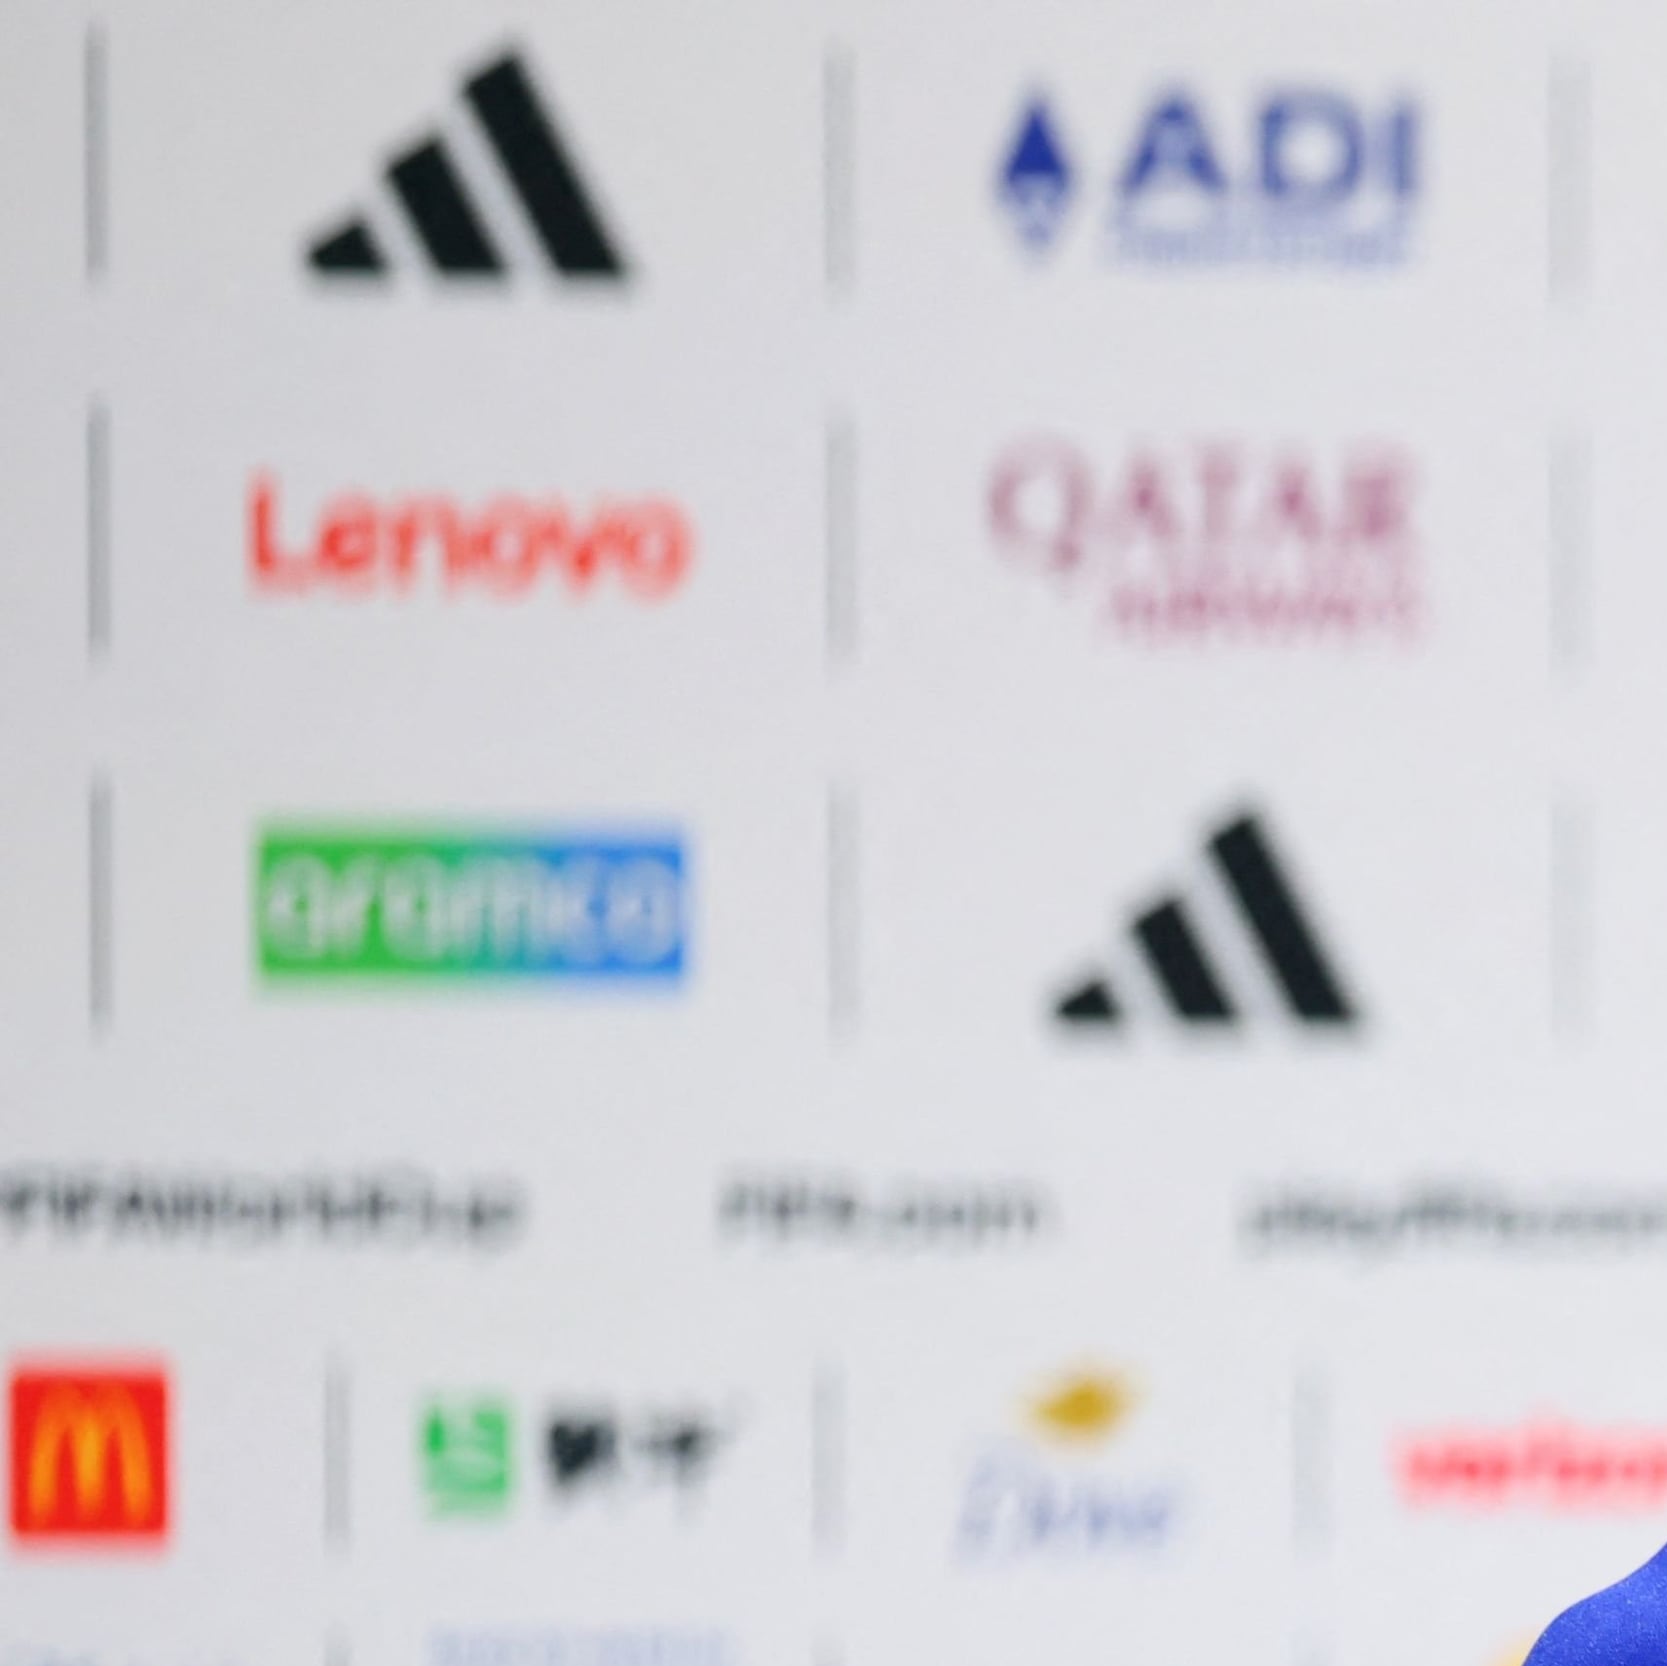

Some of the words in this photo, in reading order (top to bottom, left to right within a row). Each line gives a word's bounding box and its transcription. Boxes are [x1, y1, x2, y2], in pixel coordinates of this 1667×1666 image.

[1108, 84, 1424, 206] ADI
[248, 474, 692, 604] Lenovo
[990, 438, 1414, 584] QATAR
[266, 846, 682, 968] aramco
